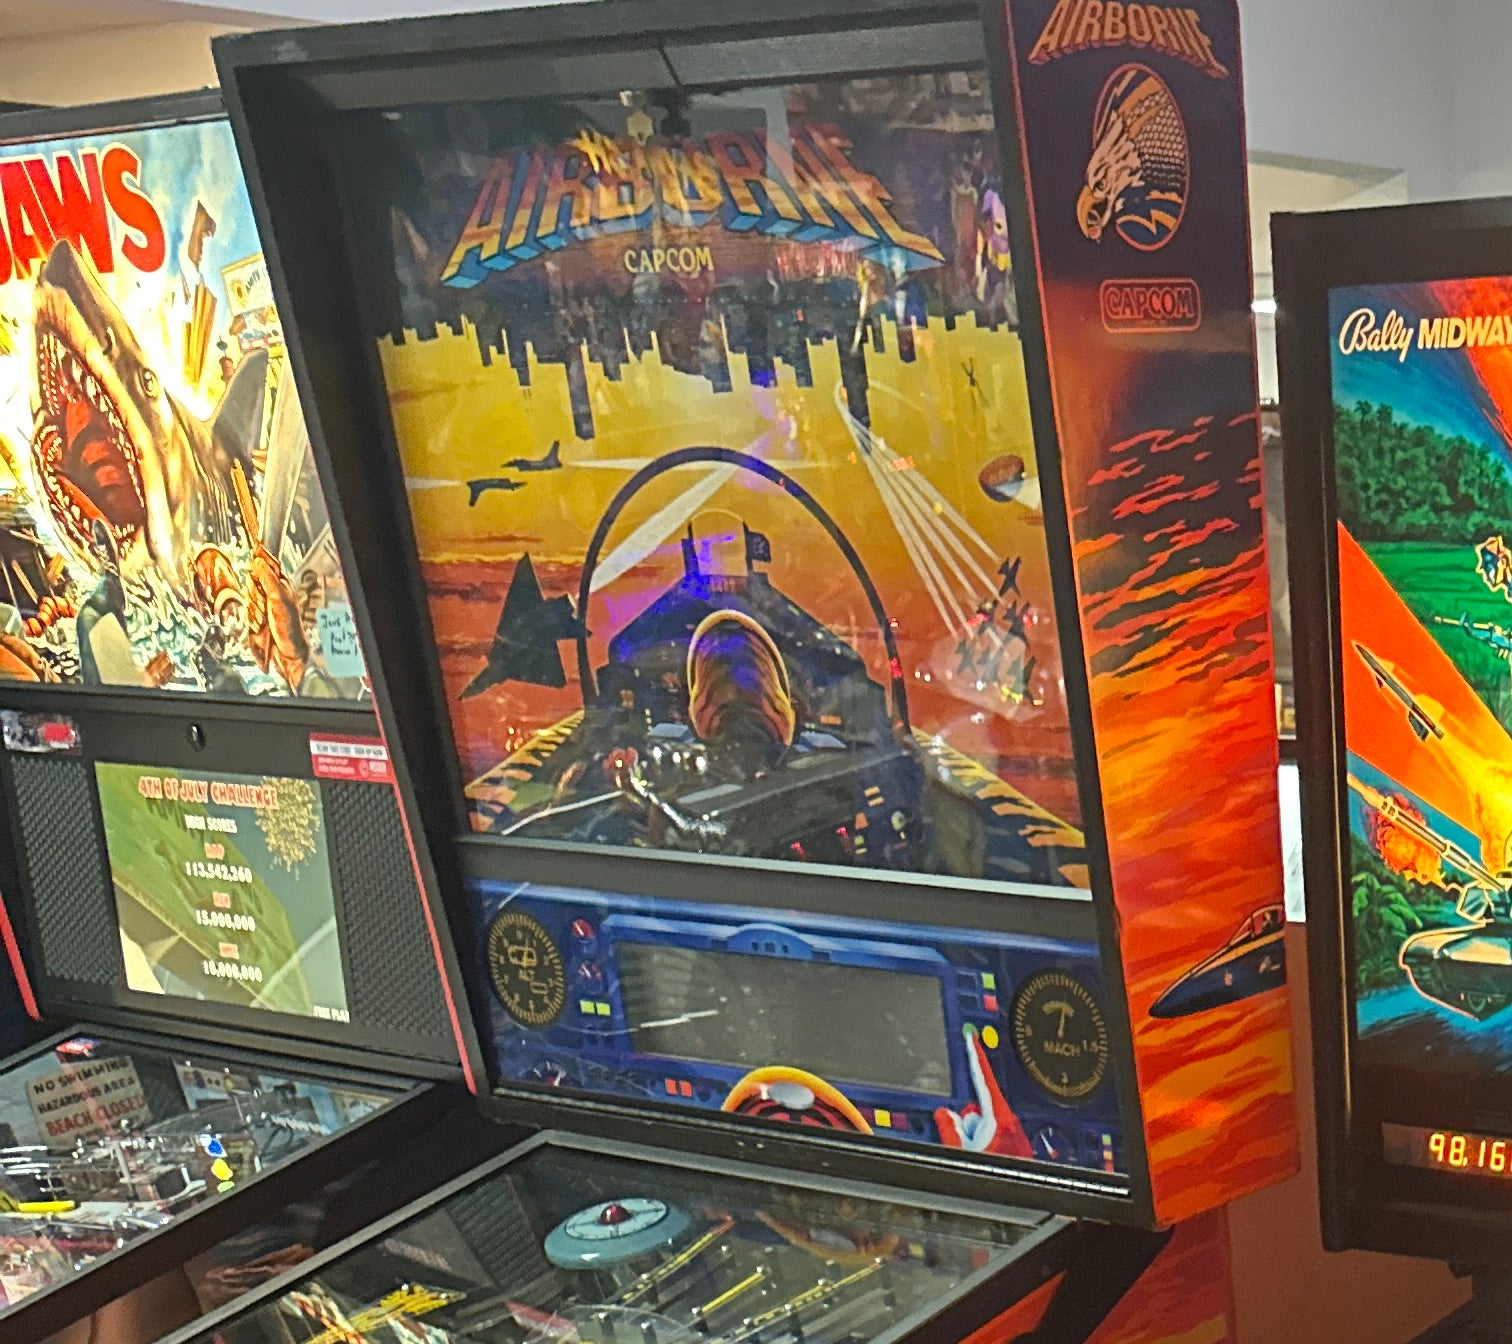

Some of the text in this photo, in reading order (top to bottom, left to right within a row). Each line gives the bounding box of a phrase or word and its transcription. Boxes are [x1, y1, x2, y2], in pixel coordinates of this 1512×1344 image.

[1028, 0, 1229, 79] AIRBORNE
[441, 122, 945, 288] AIRBORNE
[625, 246, 714, 275] CAPCOM
[1105, 287, 1194, 319] CAPCOM
[1339, 307, 1414, 363] Bally
[139, 776, 279, 810] 4TH OF JULY CHALLENGE
[1043, 1041, 1081, 1057] MACH
[33, 1057, 129, 1095] NO SWIMMING
[37, 1076, 136, 1114] HAZARDOUS AREA
[45, 1111, 94, 1136] BEACH
[95, 1093, 146, 1121] CLOSED
